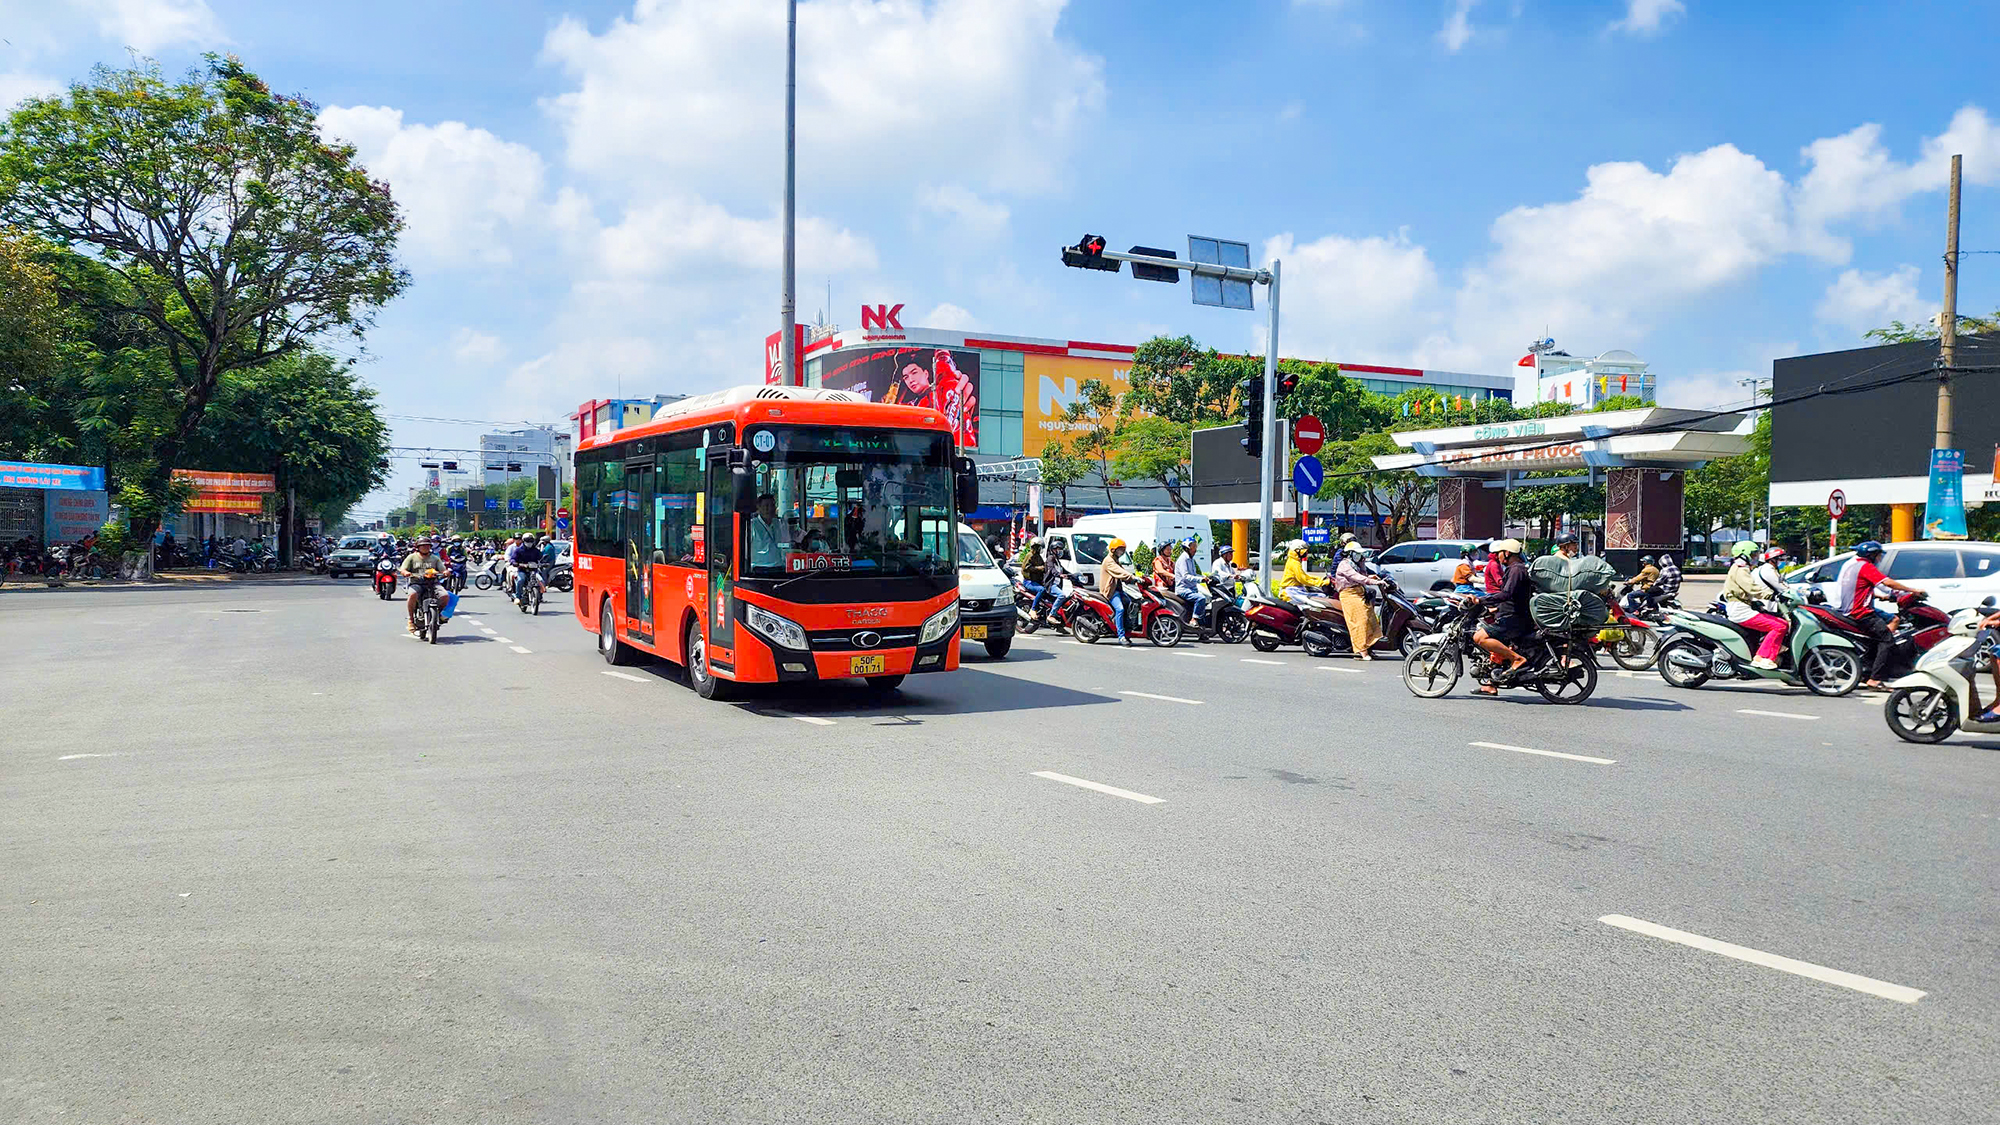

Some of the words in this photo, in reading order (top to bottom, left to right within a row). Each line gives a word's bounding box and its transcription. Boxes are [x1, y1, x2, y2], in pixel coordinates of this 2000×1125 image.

[862, 304, 904, 330] NK
[1474, 426, 1509, 440] CÔNG
[1515, 422, 1545, 437] VIÊN
[754, 434, 775, 447] CT-01
[860, 656, 875, 664] 50F
[854, 665, 881, 674] 001.71
